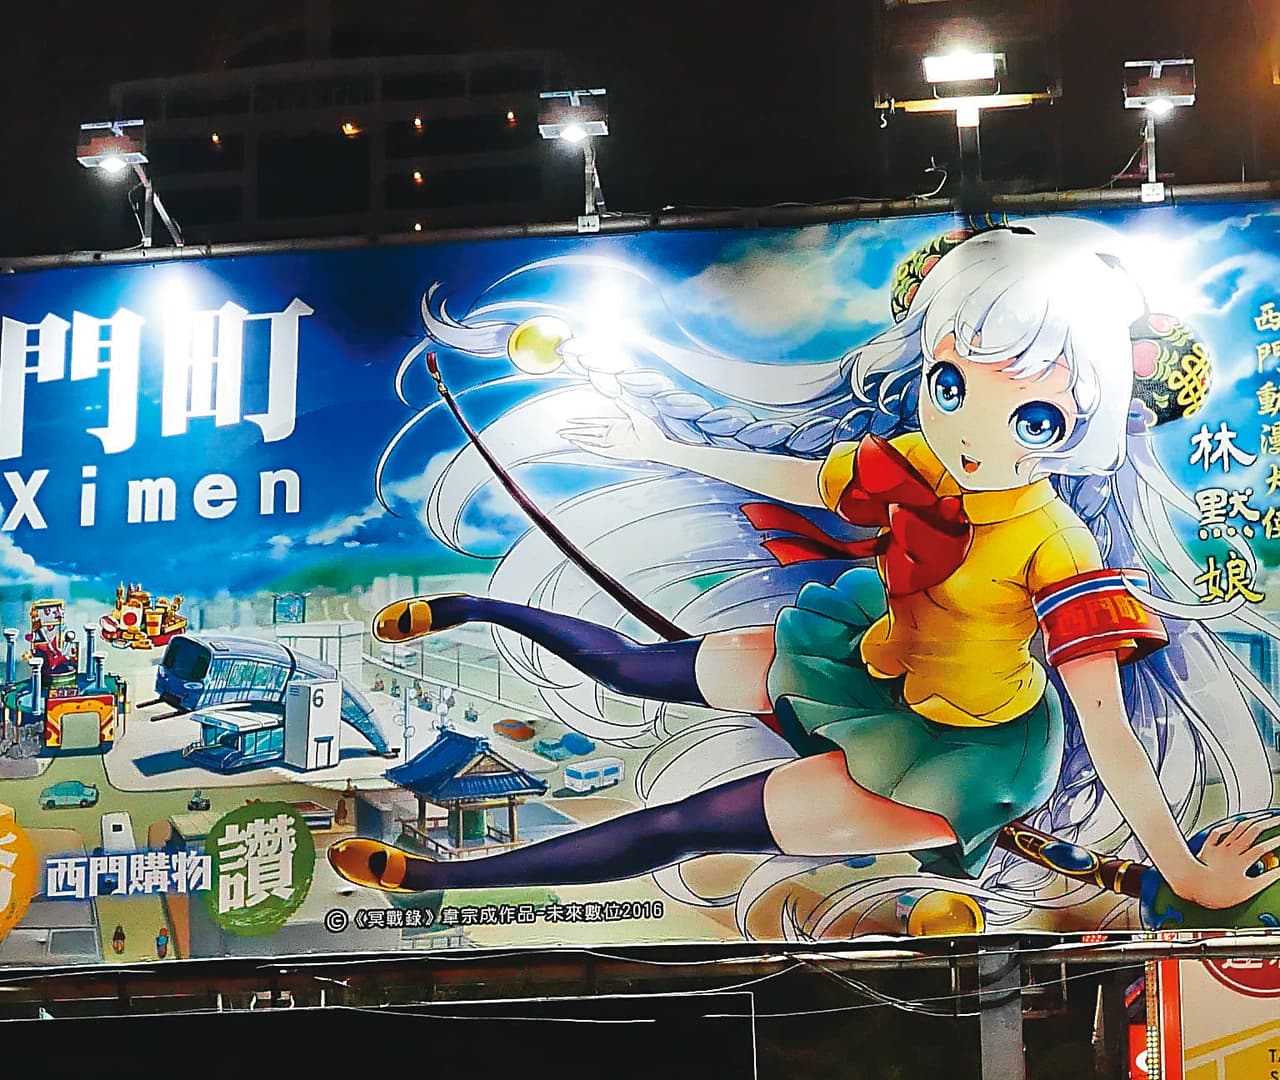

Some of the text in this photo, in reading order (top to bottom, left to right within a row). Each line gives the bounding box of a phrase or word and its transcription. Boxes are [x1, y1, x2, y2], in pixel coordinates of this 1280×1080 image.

[3, 461, 302, 531] Ximen
[312, 688, 324, 708] 6
[45, 811, 295, 911] 西門購物讚
